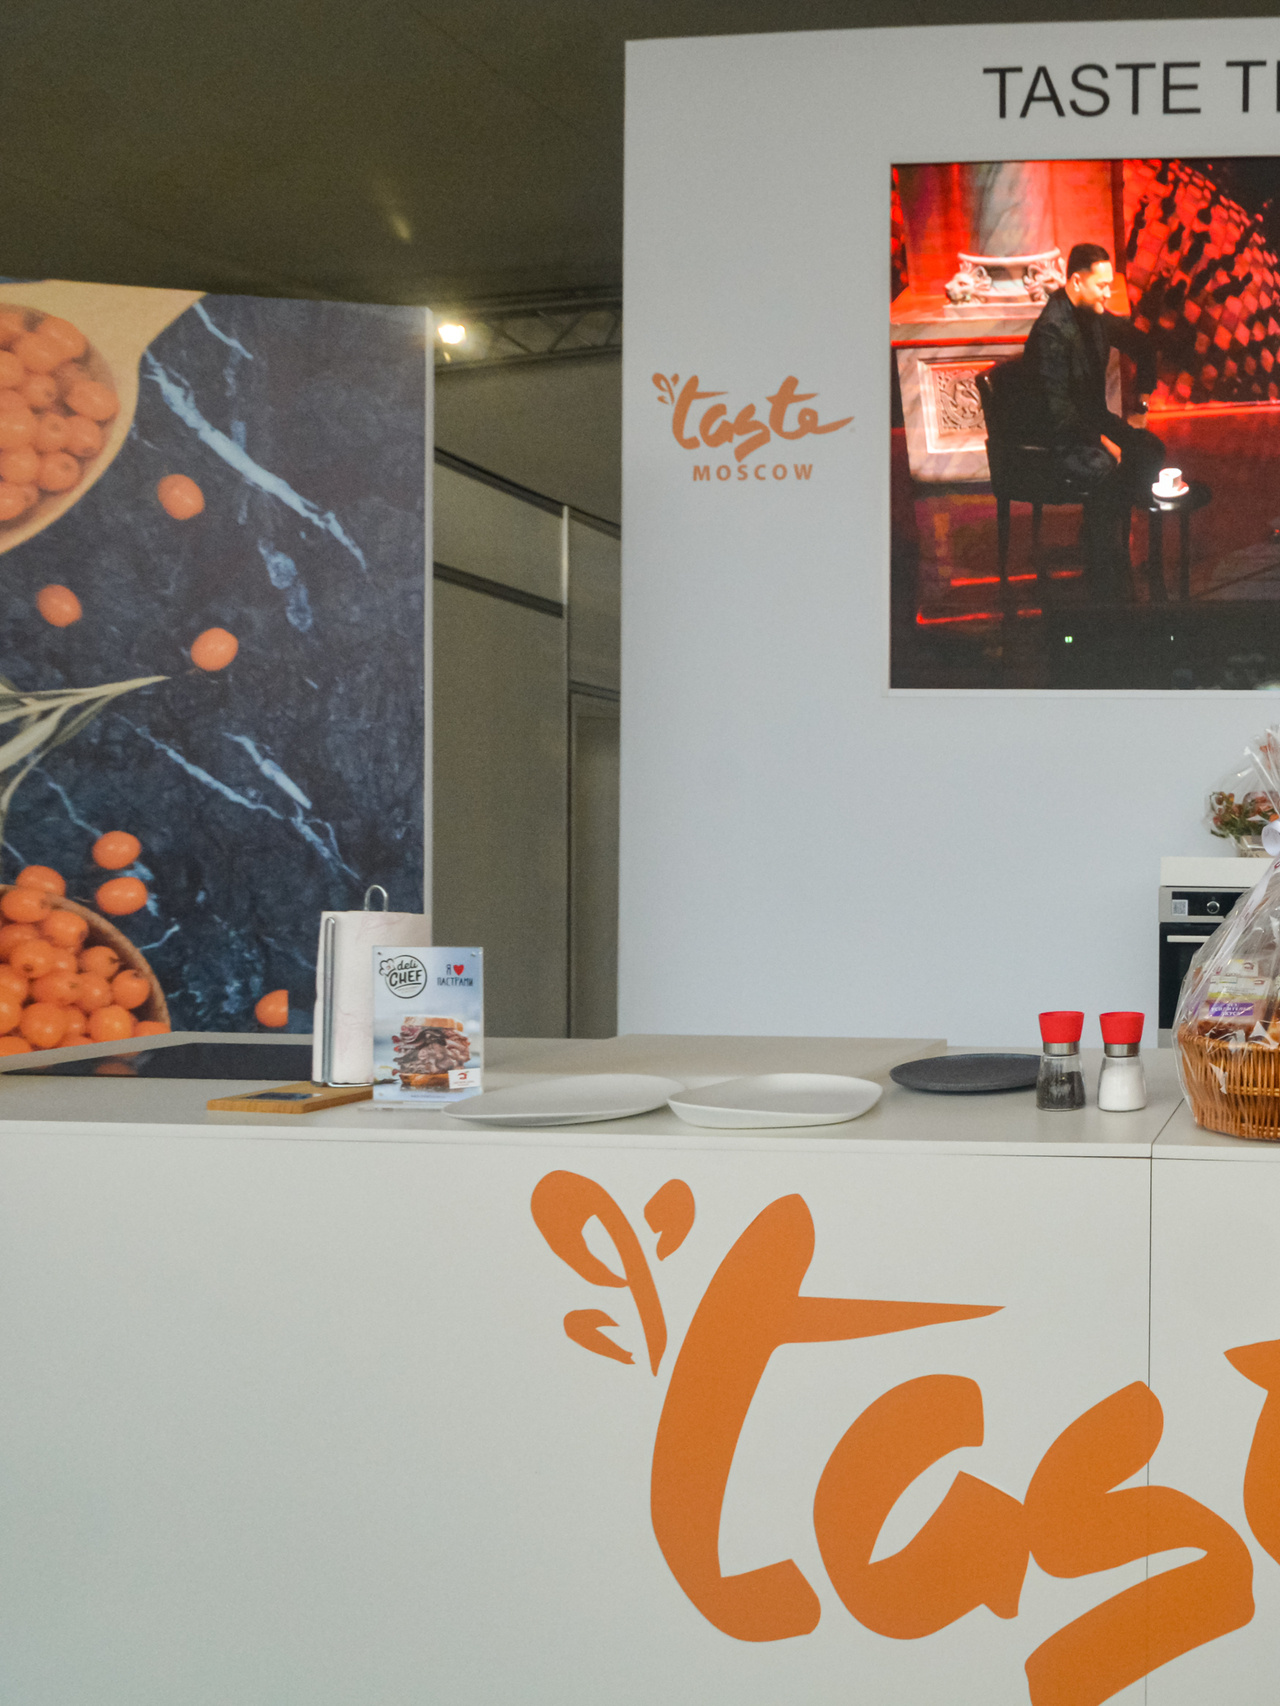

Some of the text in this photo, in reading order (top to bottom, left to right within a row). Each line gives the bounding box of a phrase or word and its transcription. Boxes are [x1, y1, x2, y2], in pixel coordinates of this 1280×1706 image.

[982, 62, 1201, 119] TASTE
[692, 463, 813, 482] MOSCOW
[397, 960, 418, 971] deli
[389, 969, 423, 987] CHEF
[436, 977, 474, 987] ПАСТРАМИ
